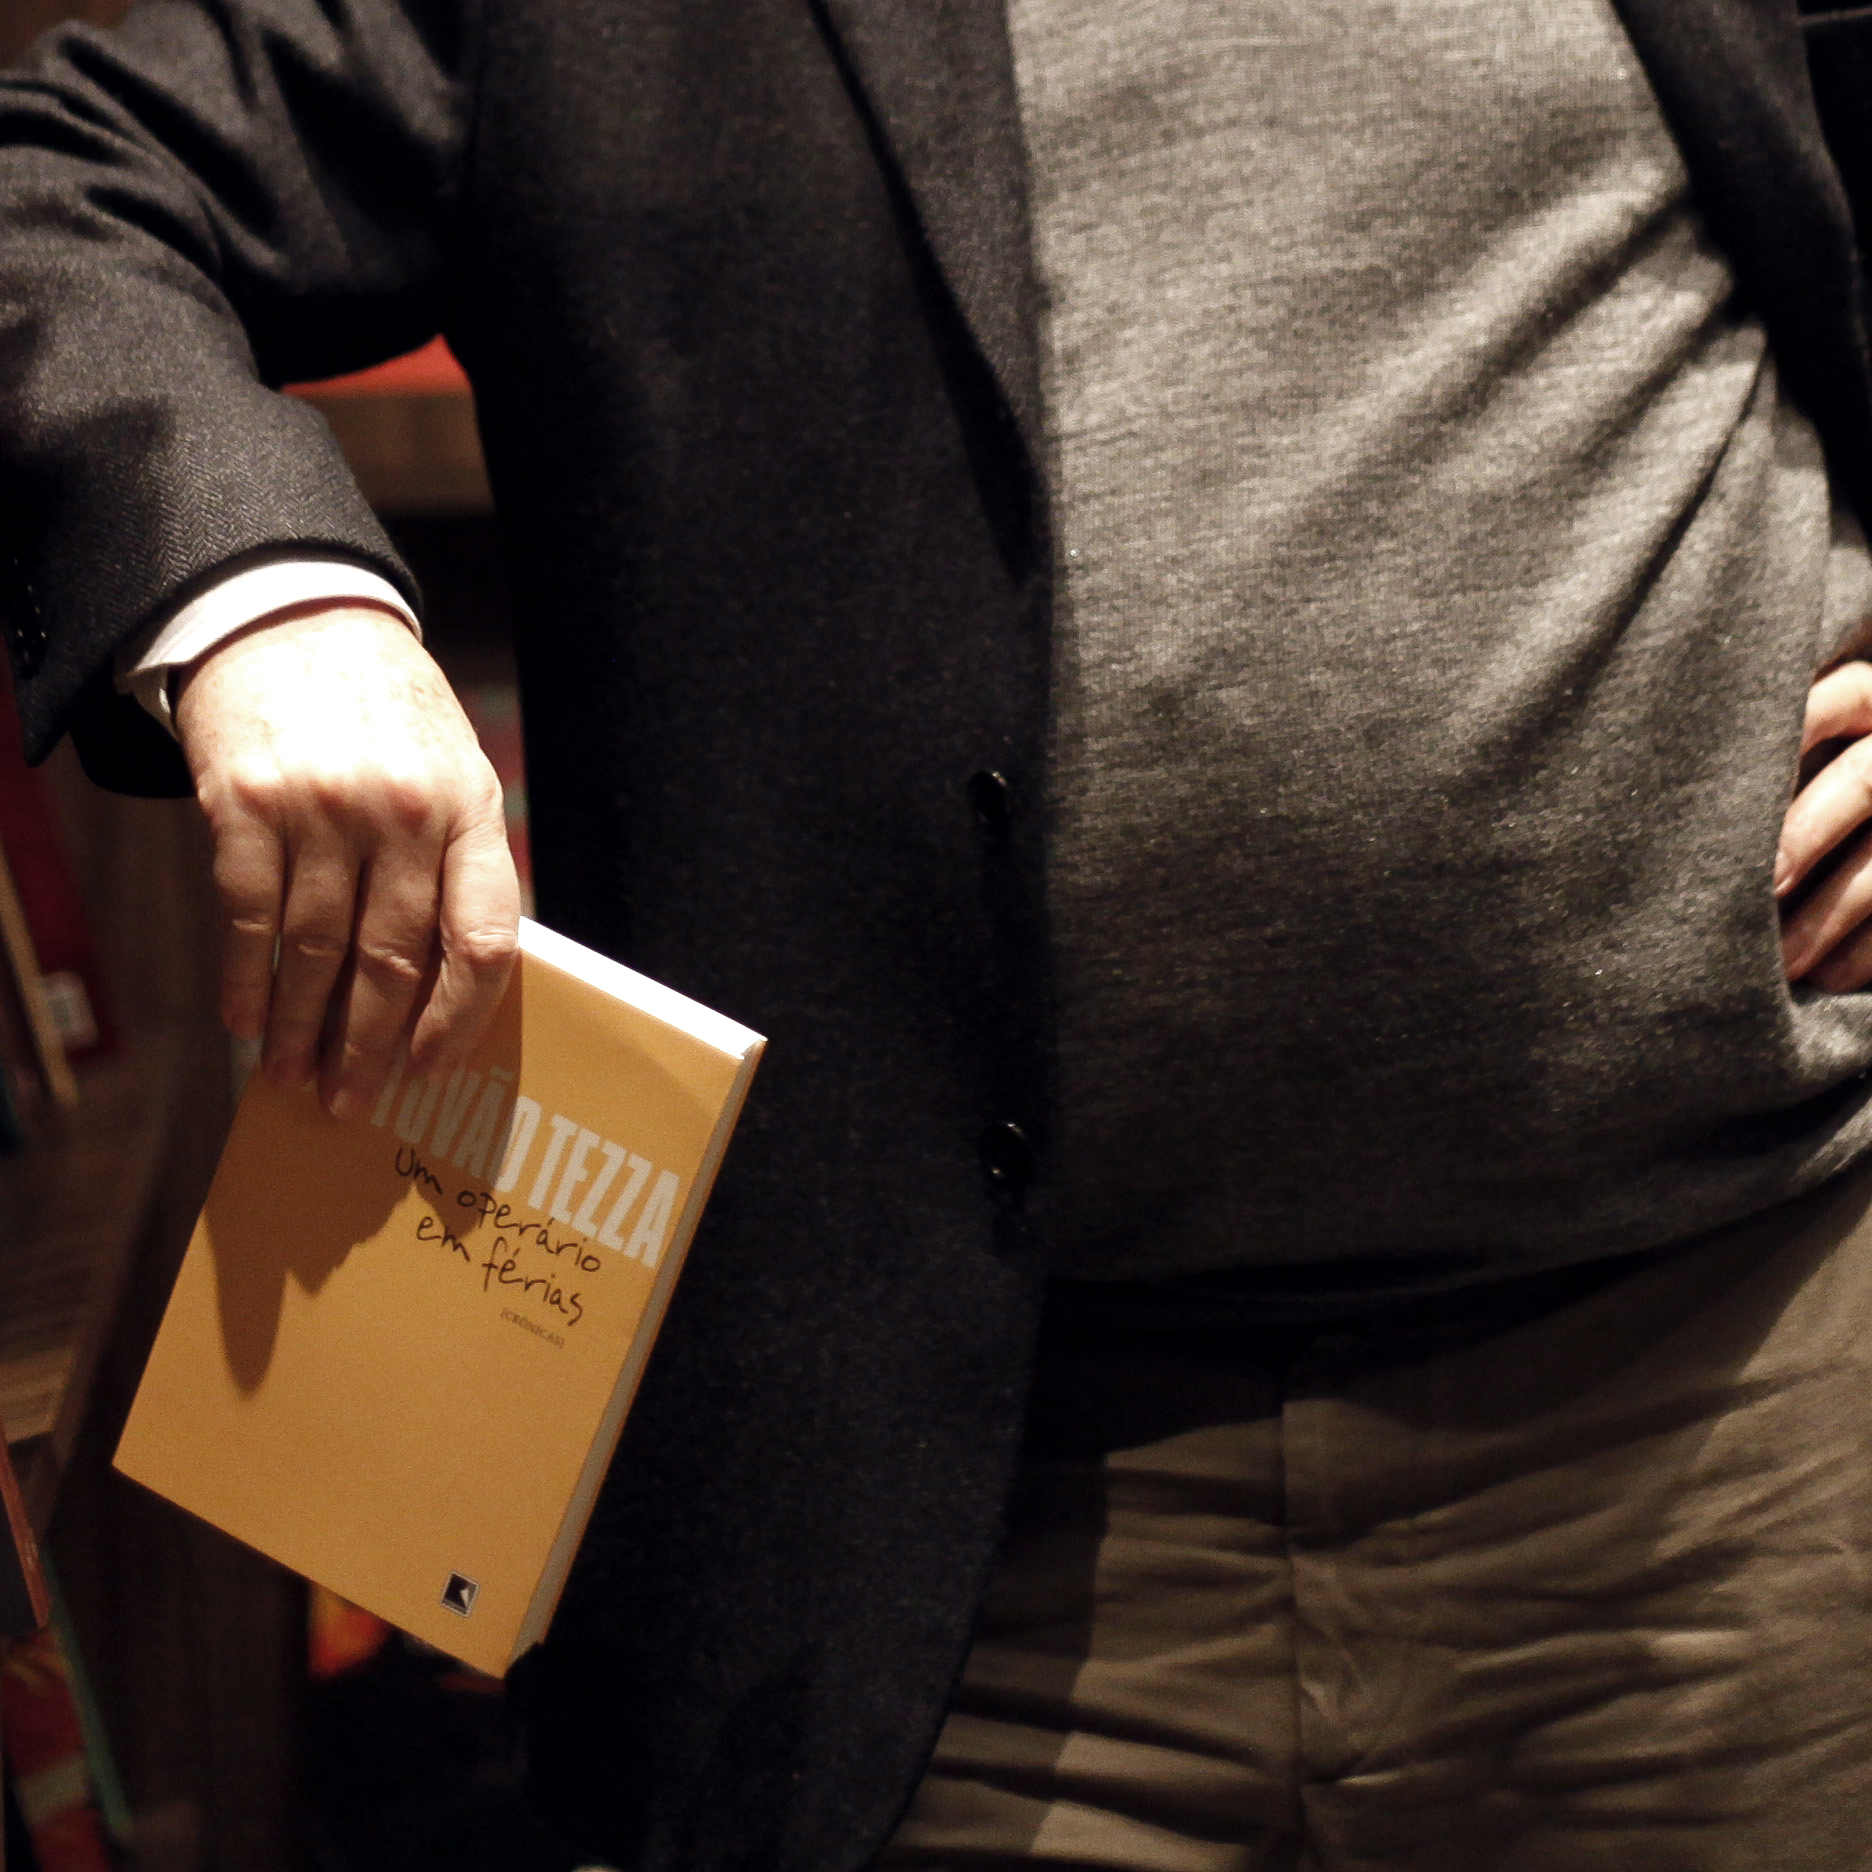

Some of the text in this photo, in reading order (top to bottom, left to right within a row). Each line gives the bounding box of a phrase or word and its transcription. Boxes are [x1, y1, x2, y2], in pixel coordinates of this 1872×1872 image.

[395, 1146, 601, 1273] Um operário
[528, 1113, 680, 1269] TEZZA
[416, 1215, 584, 1327] em férias
